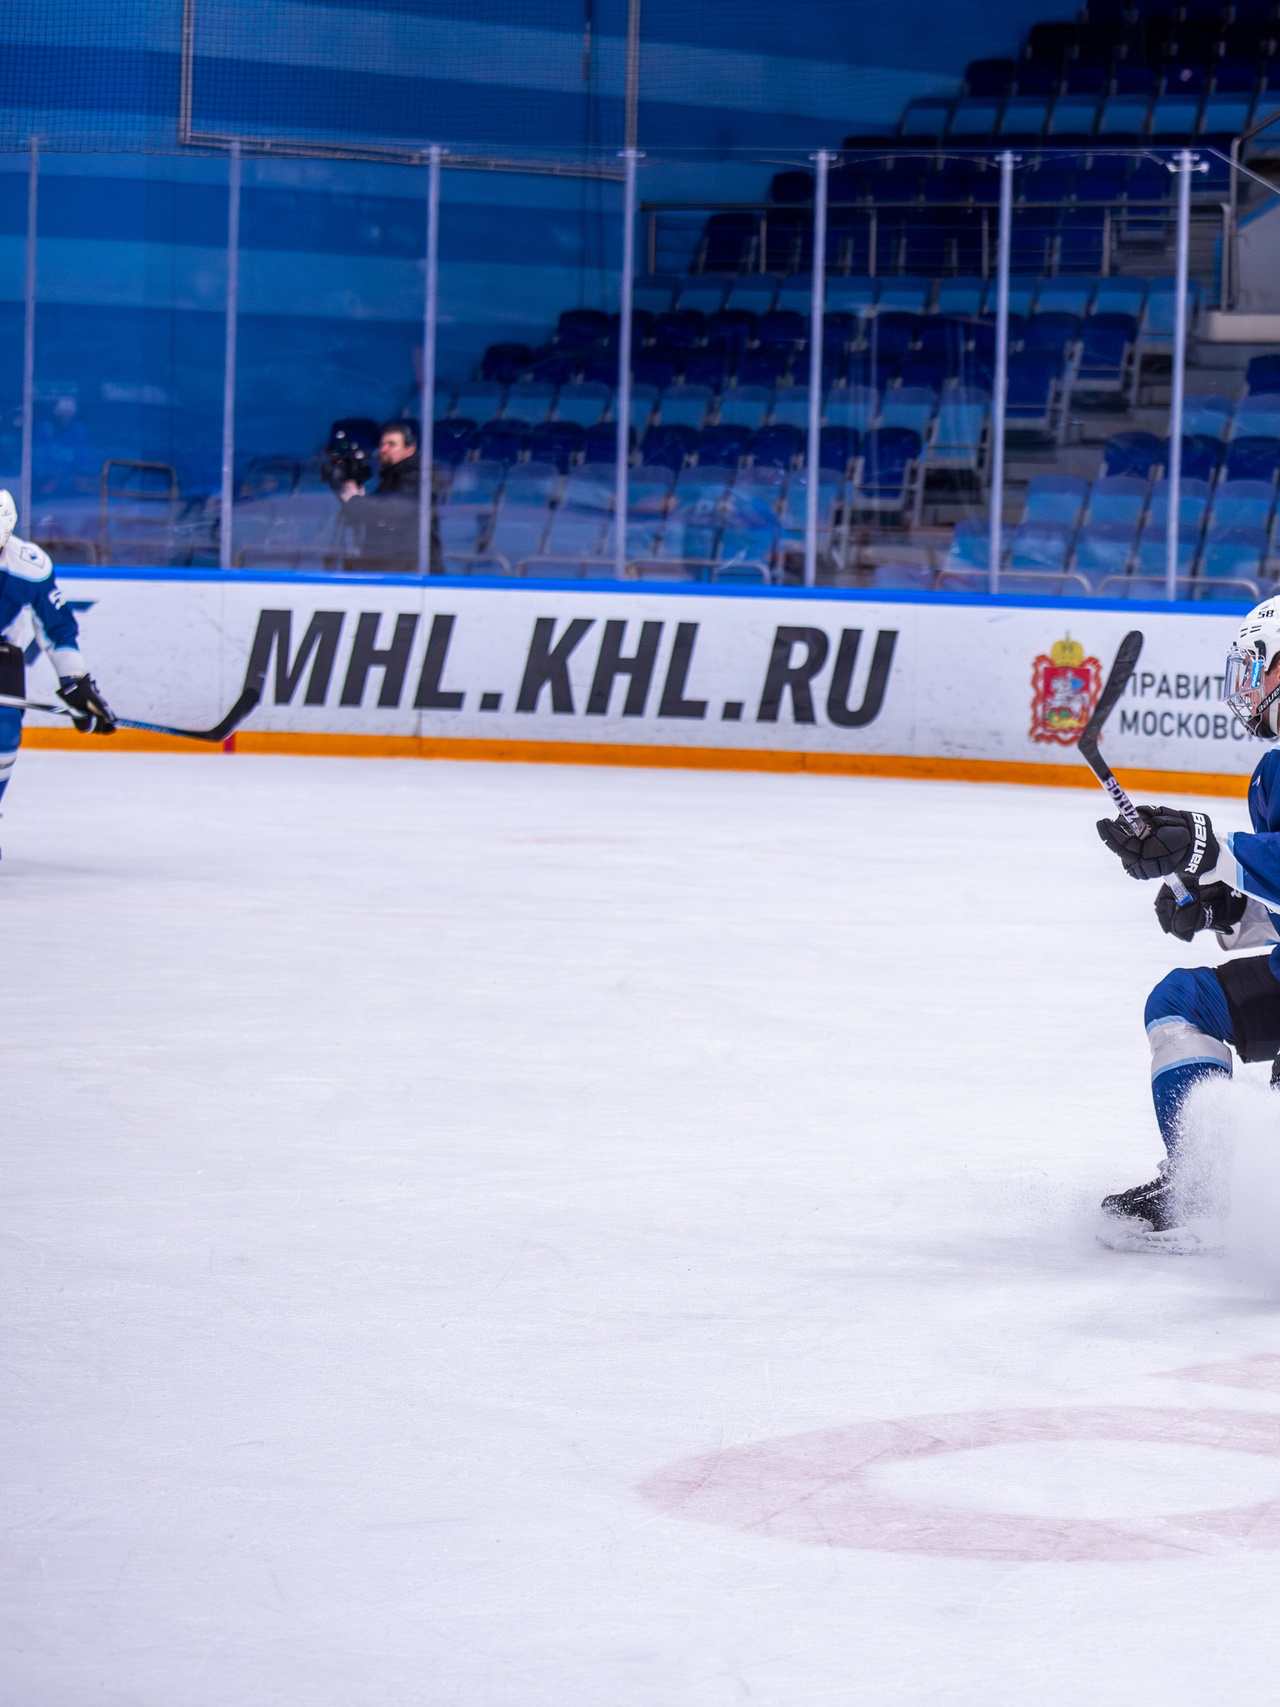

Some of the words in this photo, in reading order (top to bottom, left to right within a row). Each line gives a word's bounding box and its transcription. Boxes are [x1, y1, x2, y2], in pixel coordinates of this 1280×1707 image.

[1257, 609, 1275, 620] 58
[246, 609, 899, 729] MHL.KHL.RU
[1121, 672, 1226, 700] ПРАВИТ
[1119, 710, 1280, 742] МОСКОВС
